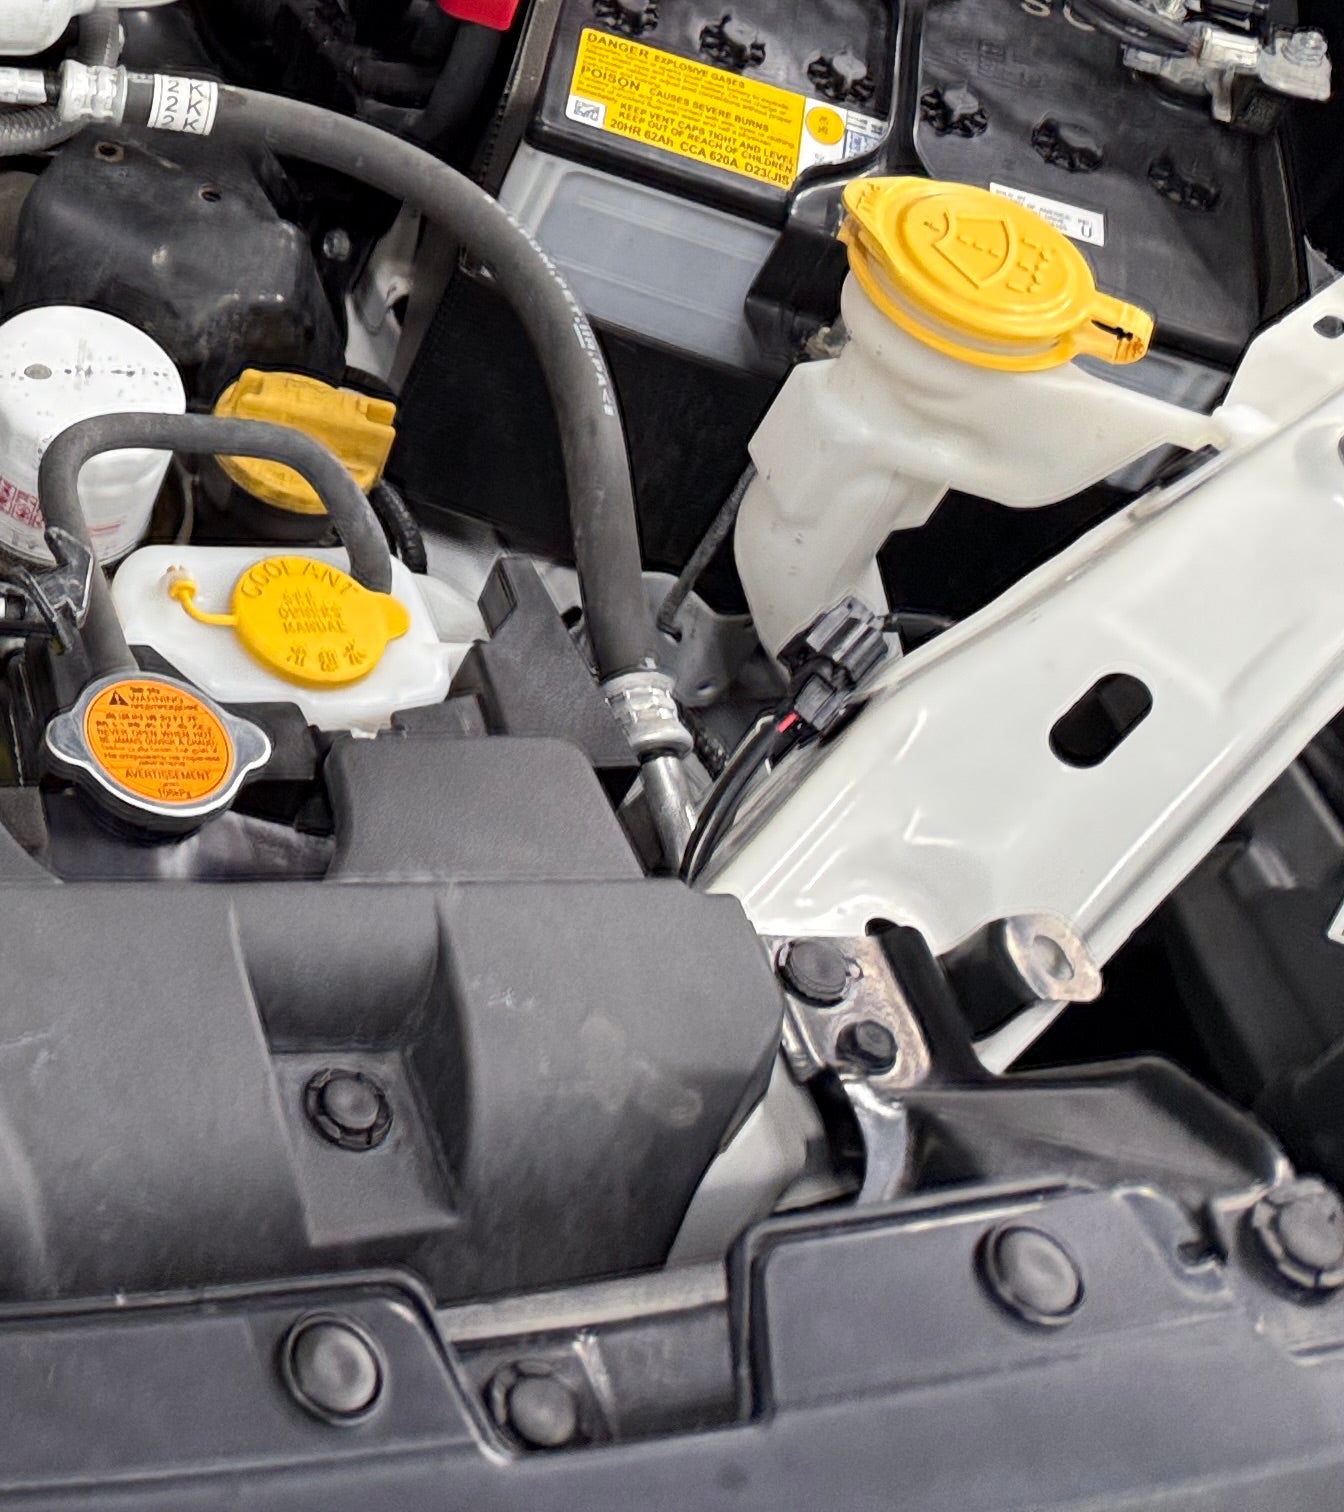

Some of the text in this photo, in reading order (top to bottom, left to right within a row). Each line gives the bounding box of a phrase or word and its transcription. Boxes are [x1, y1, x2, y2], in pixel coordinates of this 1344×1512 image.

[587, 33, 649, 57] DANGER
[654, 55, 708, 77] EXPLOSIVE
[581, 65, 640, 91] POISON
[610, 119, 641, 137] 20HR
[680, 141, 707, 159] CCA
[241, 560, 359, 598] COOLANT
[283, 619, 346, 634] MANUAL
